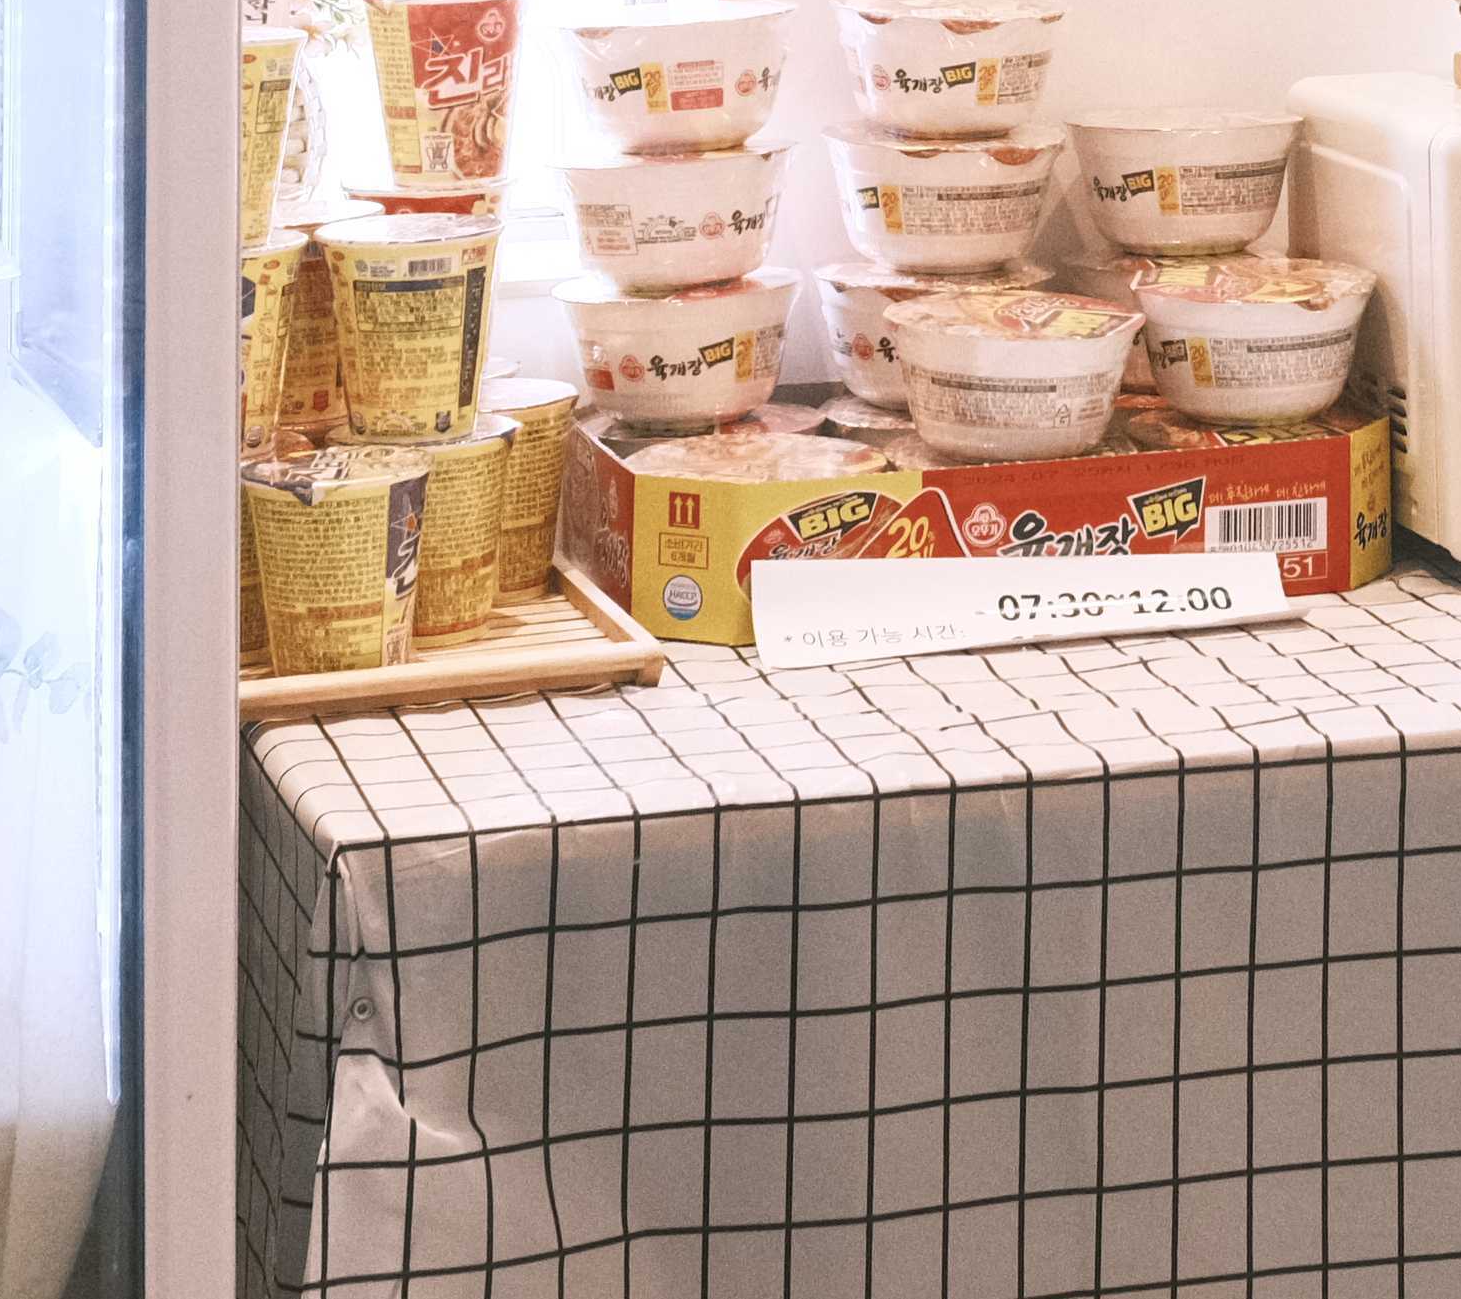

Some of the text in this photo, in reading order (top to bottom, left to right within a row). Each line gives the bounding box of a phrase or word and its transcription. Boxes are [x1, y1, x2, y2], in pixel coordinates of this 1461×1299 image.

[614, 73, 640, 90] BIG
[892, 68, 944, 94] 육개장
[945, 66, 973, 82] BIG
[1125, 174, 1152, 189] BIG
[647, 343, 733, 381] 육개장 BIG
[798, 496, 871, 540] BIG
[1141, 492, 1198, 534] BIG
[1354, 508, 1388, 551] 육개장
[668, 590, 698, 601] HACCP
[801, 628, 849, 649] 이용
[856, 626, 904, 646] 가능
